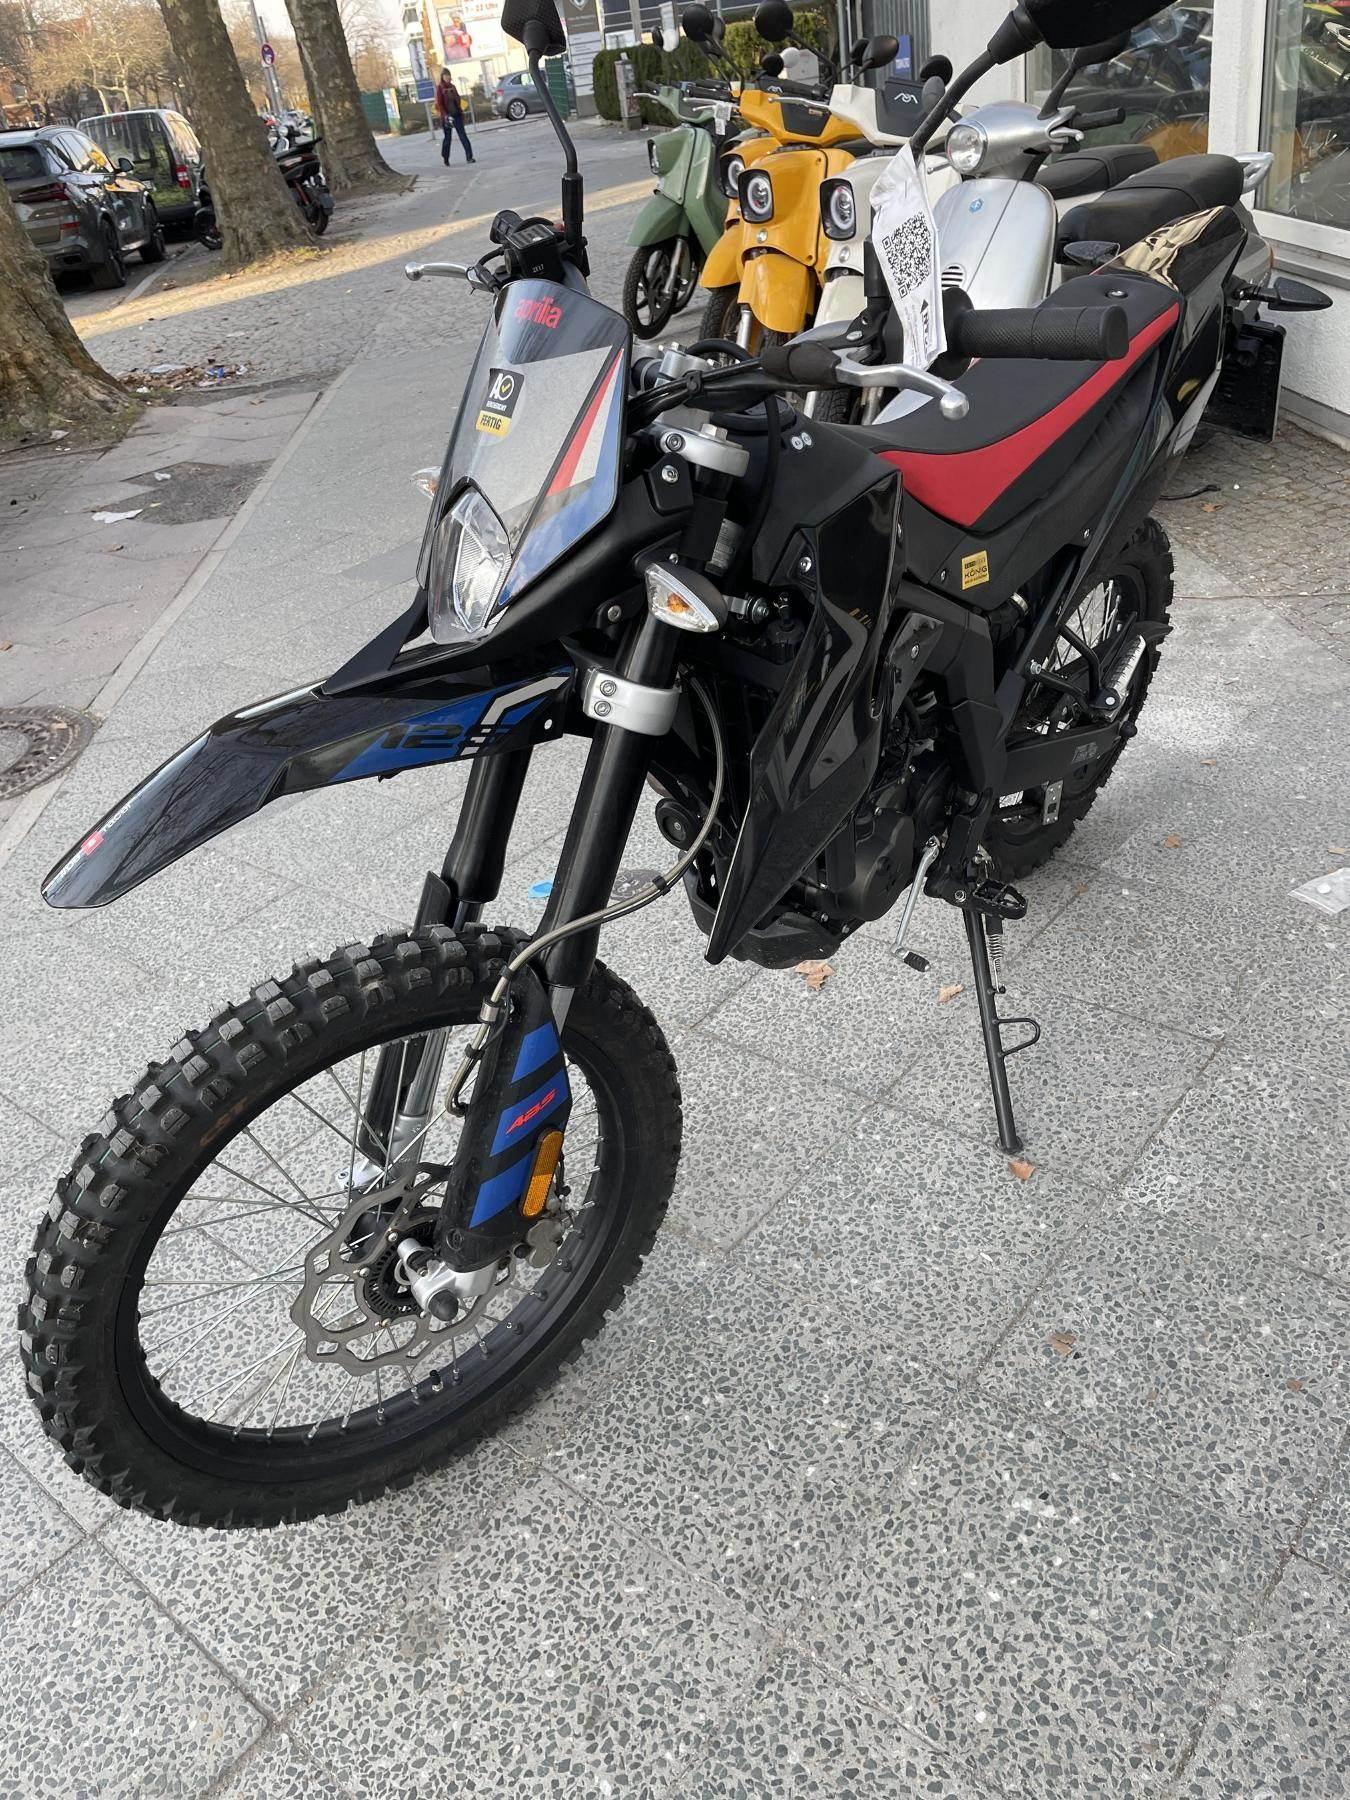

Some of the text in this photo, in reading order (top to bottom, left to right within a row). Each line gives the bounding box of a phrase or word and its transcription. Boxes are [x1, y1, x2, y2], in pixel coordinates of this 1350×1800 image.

[480, 414, 503, 431] FERTIG
[964, 565, 988, 579] KÖNIG
[102, 803, 131, 832] racer
